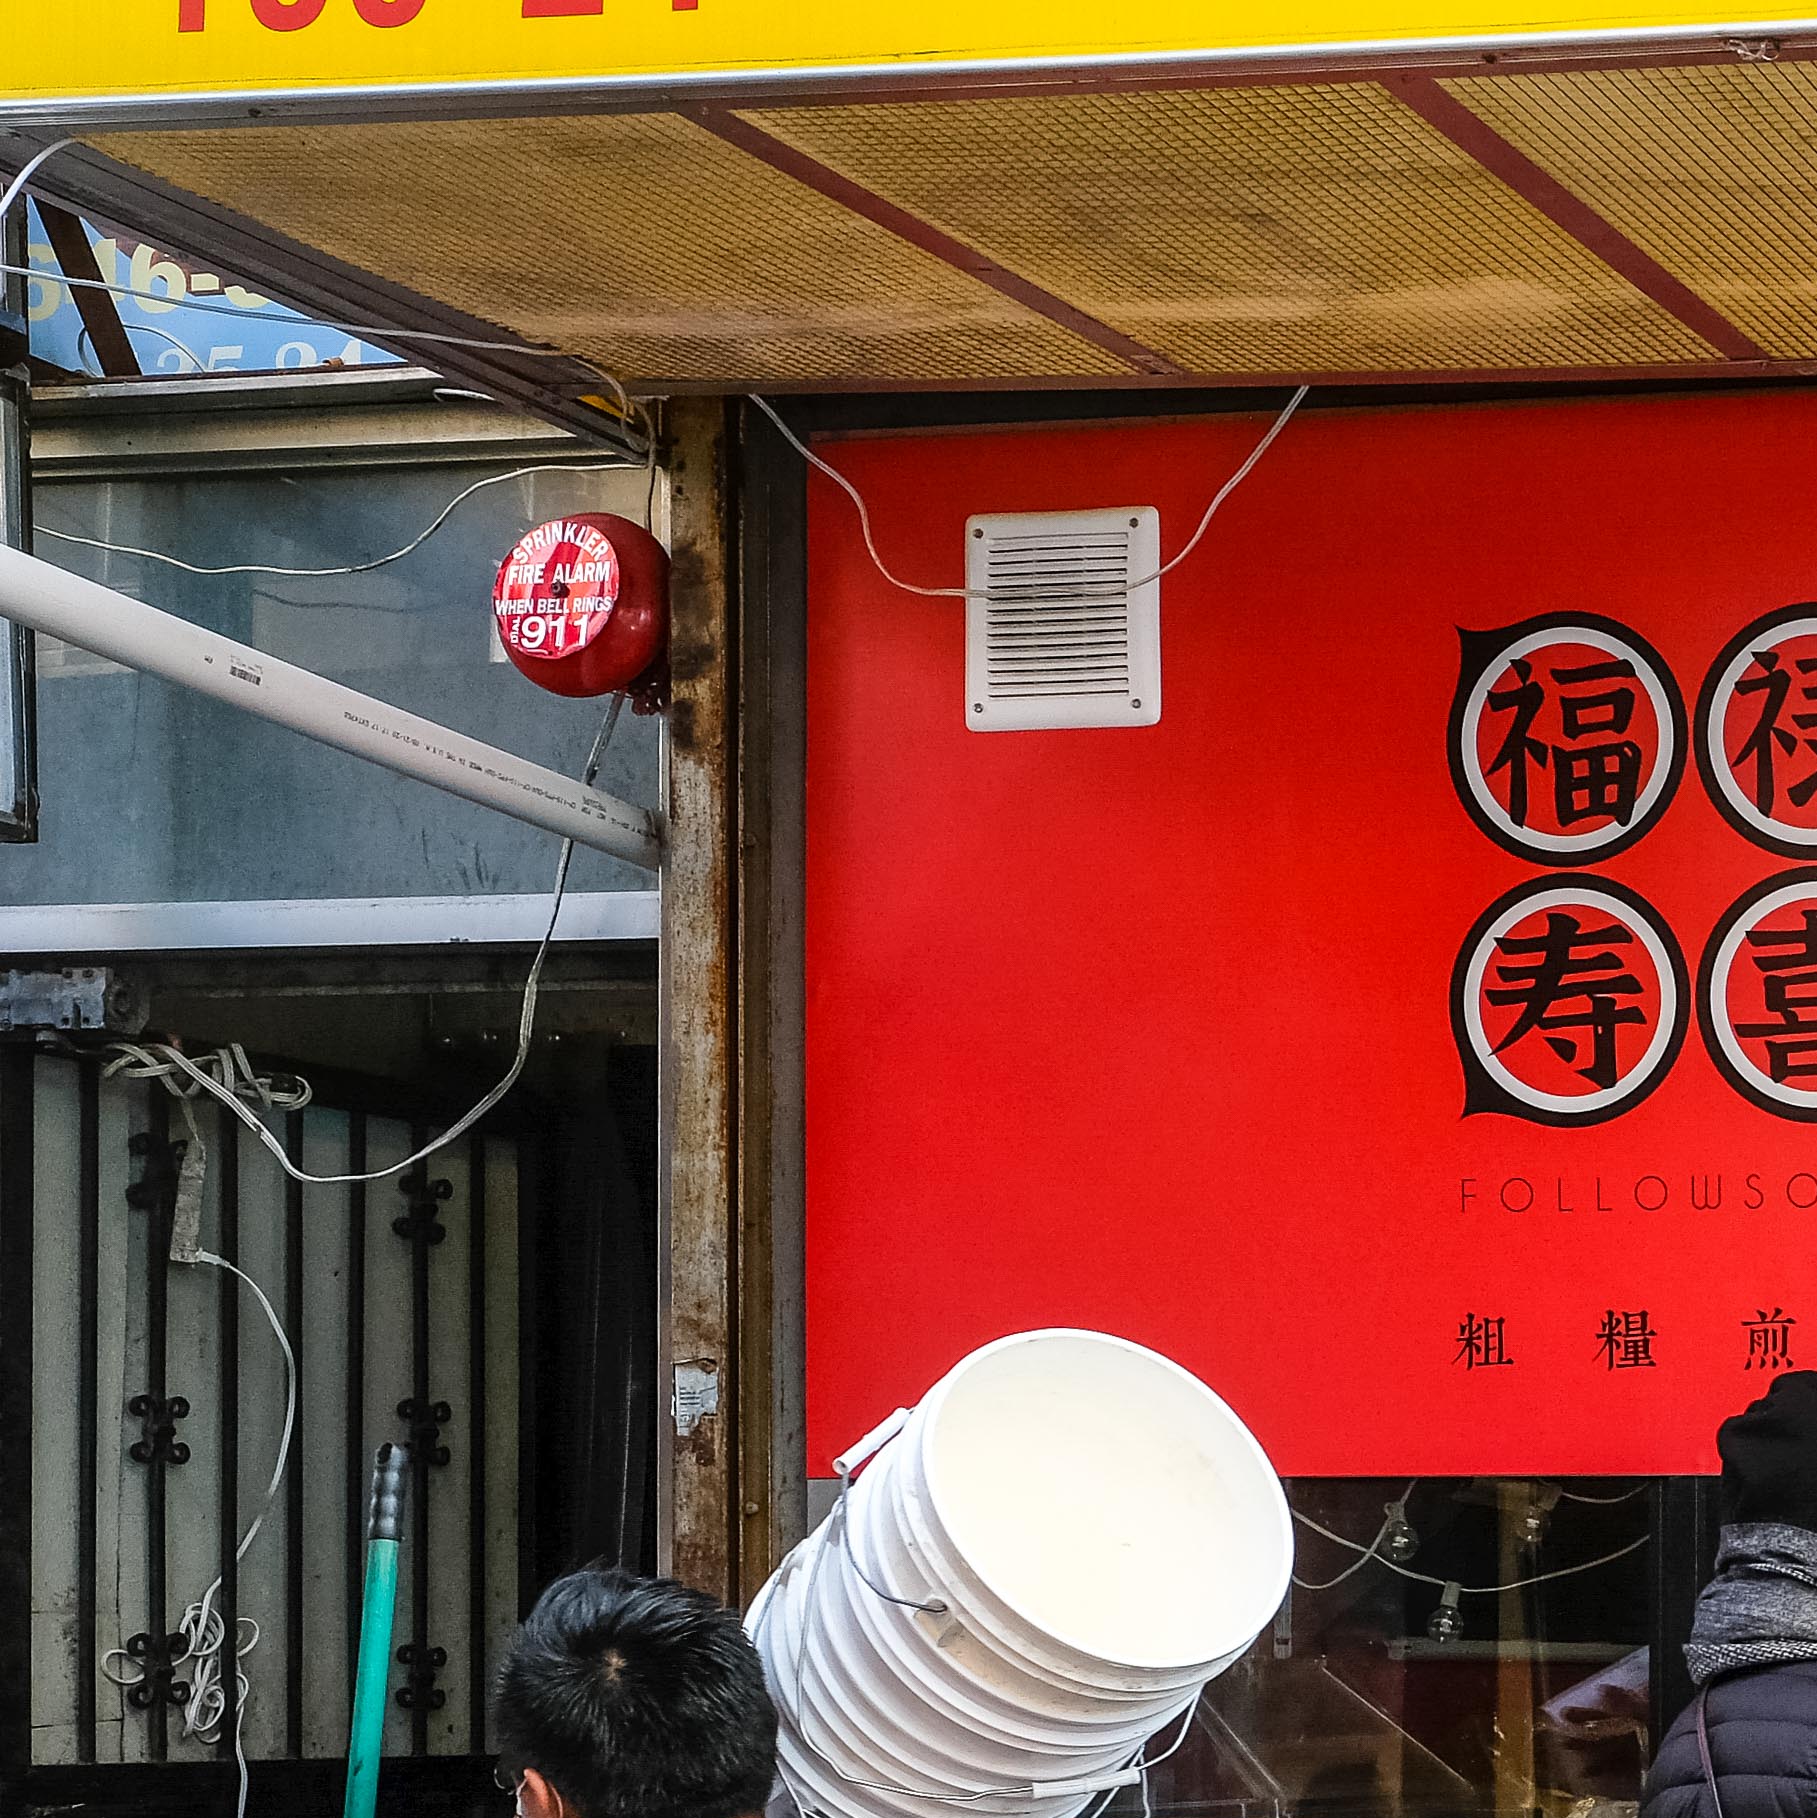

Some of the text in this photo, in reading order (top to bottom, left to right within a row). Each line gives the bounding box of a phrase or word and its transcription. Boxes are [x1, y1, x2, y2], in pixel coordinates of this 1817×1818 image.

[512, 520, 609, 564] SPRINKLER
[508, 561, 610, 585] FIRE ALARM
[495, 597, 613, 615] WHEN BELL RINGS
[511, 617, 520, 643] DIAL
[520, 614, 589, 648] 911
[1486, 656, 1643, 830] 福
[1485, 912, 1647, 1090] 寿
